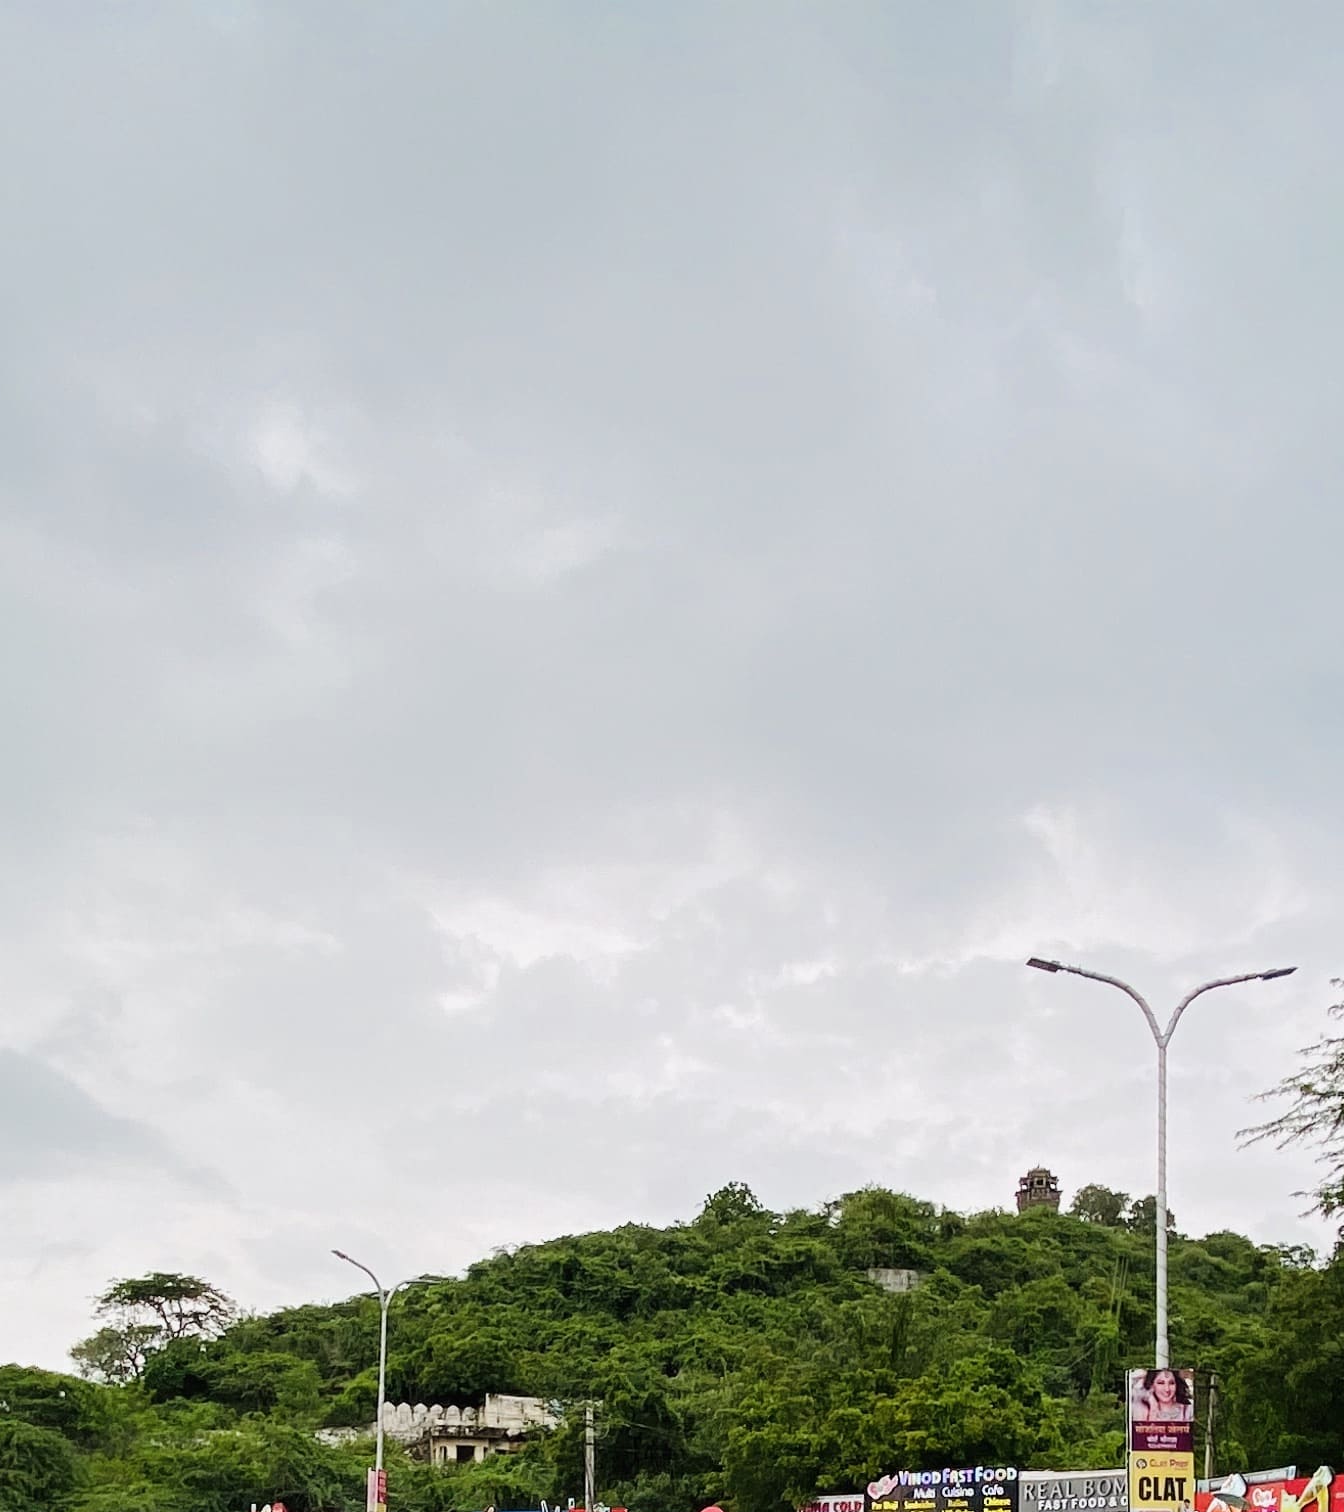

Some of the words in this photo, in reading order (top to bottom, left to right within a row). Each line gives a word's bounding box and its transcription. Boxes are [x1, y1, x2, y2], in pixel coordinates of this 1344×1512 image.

[899, 1471, 941, 1486] VINOD
[942, 1468, 973, 1484] FAST
[975, 1466, 1017, 1482] FOOD
[1024, 1481, 1076, 1500] REAL
[1138, 1476, 1186, 1501] CLAT
[1038, 1499, 1068, 1511] FAST
[1071, 1497, 1106, 1509] FOOD
